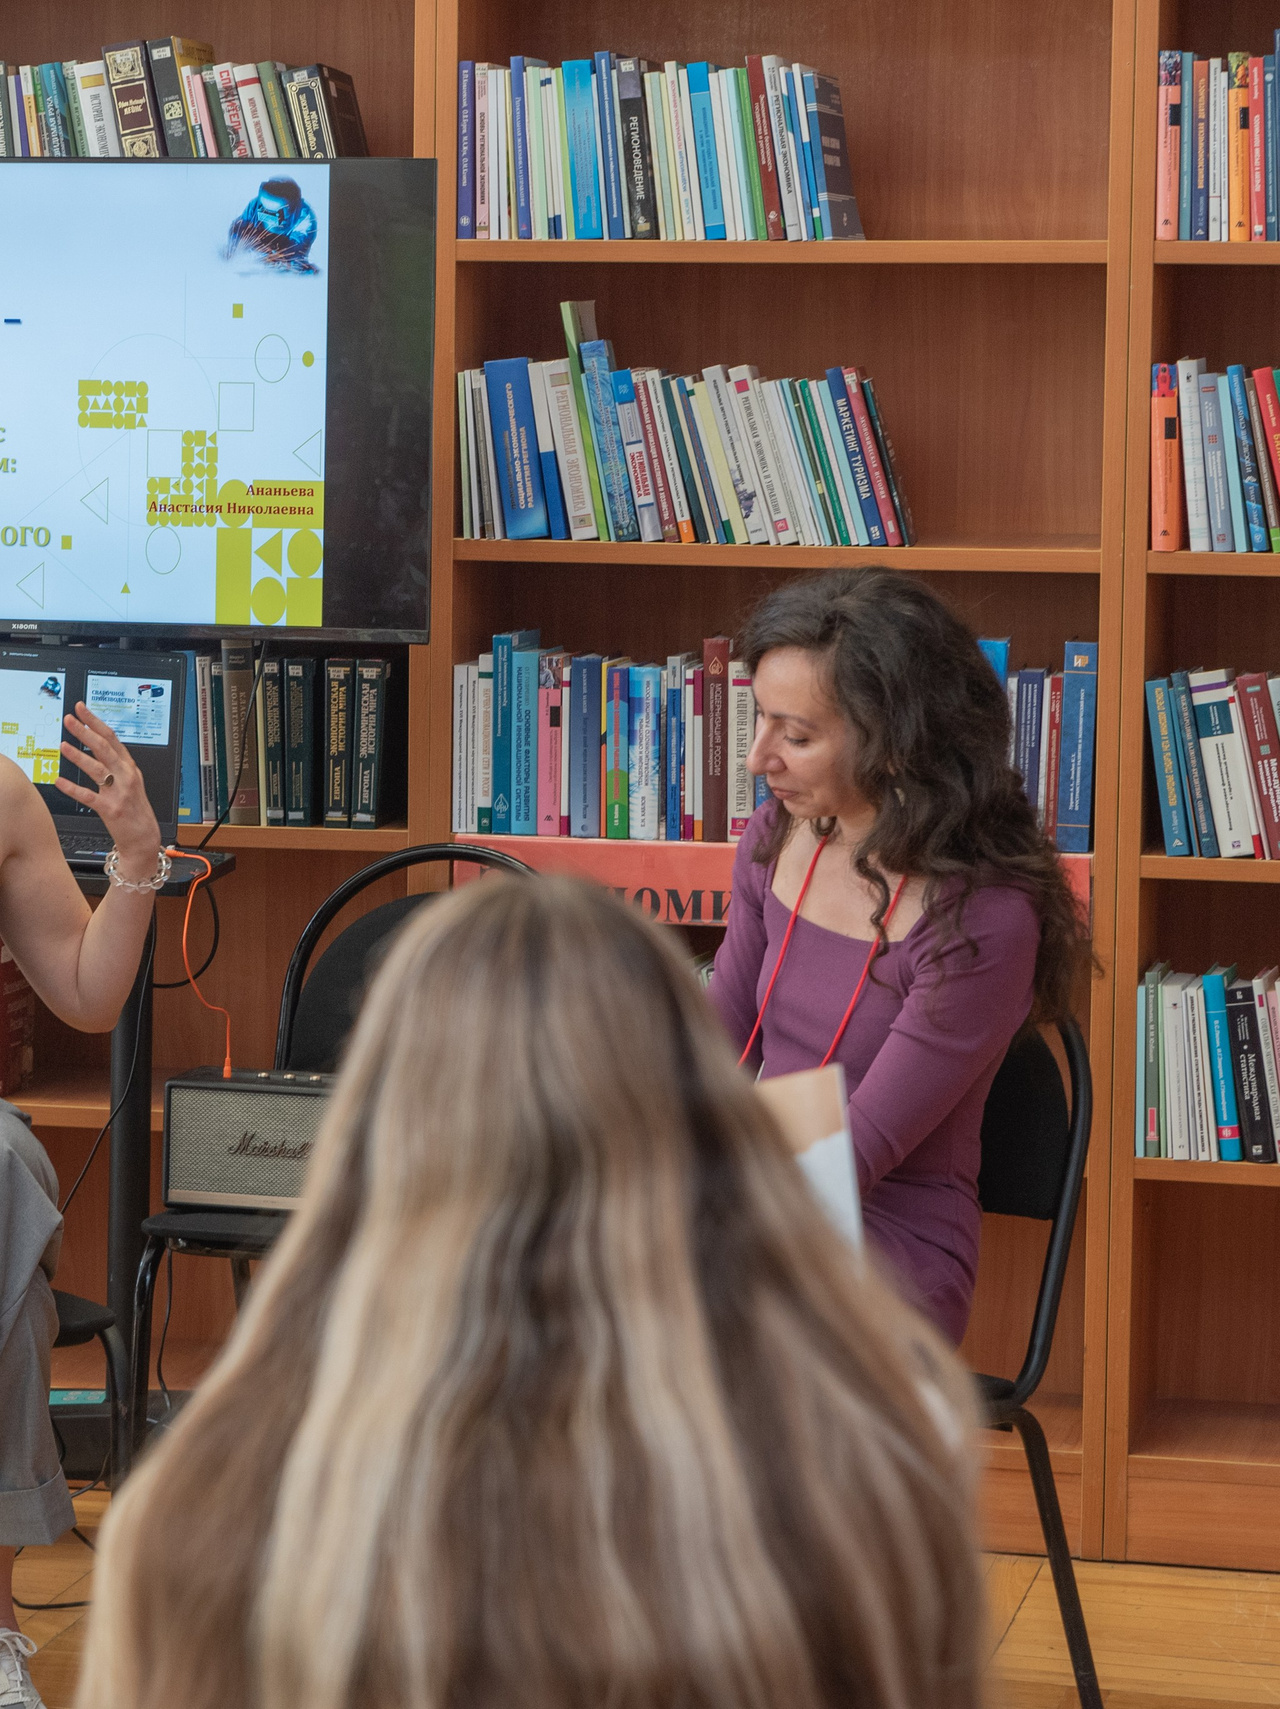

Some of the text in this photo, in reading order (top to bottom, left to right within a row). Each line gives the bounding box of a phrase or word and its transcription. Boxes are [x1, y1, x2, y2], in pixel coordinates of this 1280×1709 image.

[90, 93, 104, 122] ИСТОРИЯ
[219, 69, 243, 132] СПАСИТЕЛЬ
[757, 94, 770, 135] Экономическая
[628, 115, 646, 201] РЕГИОНОВЕДЕНИЕ
[773, 94, 793, 195] РЕГИОНАЛЬНАЯ ЭКОНОМИКА
[505, 382, 526, 509] СОЦИАЛЬНО-ЭКОНОМИЧЕСКОГО
[519, 426, 534, 509] РАЗВИТИЯ РЕГИОНА
[556, 389, 586, 512] РЕГИОНАЛЬНАЯ ЭКОНОМИКА
[629, 452, 643, 498] ЭКОНОМИКА
[636, 450, 651, 497] РЕГИОНАЛЬНАЯ
[741, 396, 781, 516] РЕГИОНАЛЬНАЯ ЭКОНОМИКА УПРАВЛЕНИЕ
[835, 398, 860, 453] МАРКЕТИНГ
[853, 454, 871, 500] ТУРИЗМА
[860, 416, 887, 500] ЭКОНОМИЧЕСКАЯ ИСТОРИЯ
[148, 500, 315, 516] Анастасия Николаевна
[246, 485, 315, 497] Ананьева
[91, 689, 126, 697] СВАРОЧНОЕ
[91, 696, 136, 704] ПРОИЗВОДСТВО
[329, 680, 339, 757] ЭКОНОМИЧЕСКАЯ
[337, 685, 347, 752] ИСТОРИЯ МИРА
[359, 682, 370, 759] ЭКОНОМИЧЕСКАЯ
[367, 687, 378, 754] ИСТОРИЯ МИРА
[515, 666, 523, 822] НАЦИОНАЛЬНОЙ ИННОВАЦИОННОЙ СИСТЕМЫ
[523, 709, 531, 822] ОСНОВНЫЕ ФАКТОРЫ РАЗВИТИЯ
[735, 691, 749, 813] НАЦИОНАЛЬНАЯ ЭКОНОМИКА
[238, 793, 246, 805] 2
[333, 765, 341, 801] ЕВРОПА
[361, 769, 371, 805] ЕВРОПА
[1239, 1053, 1252, 1101] статистика
[1246, 1053, 1262, 1121] Международная
